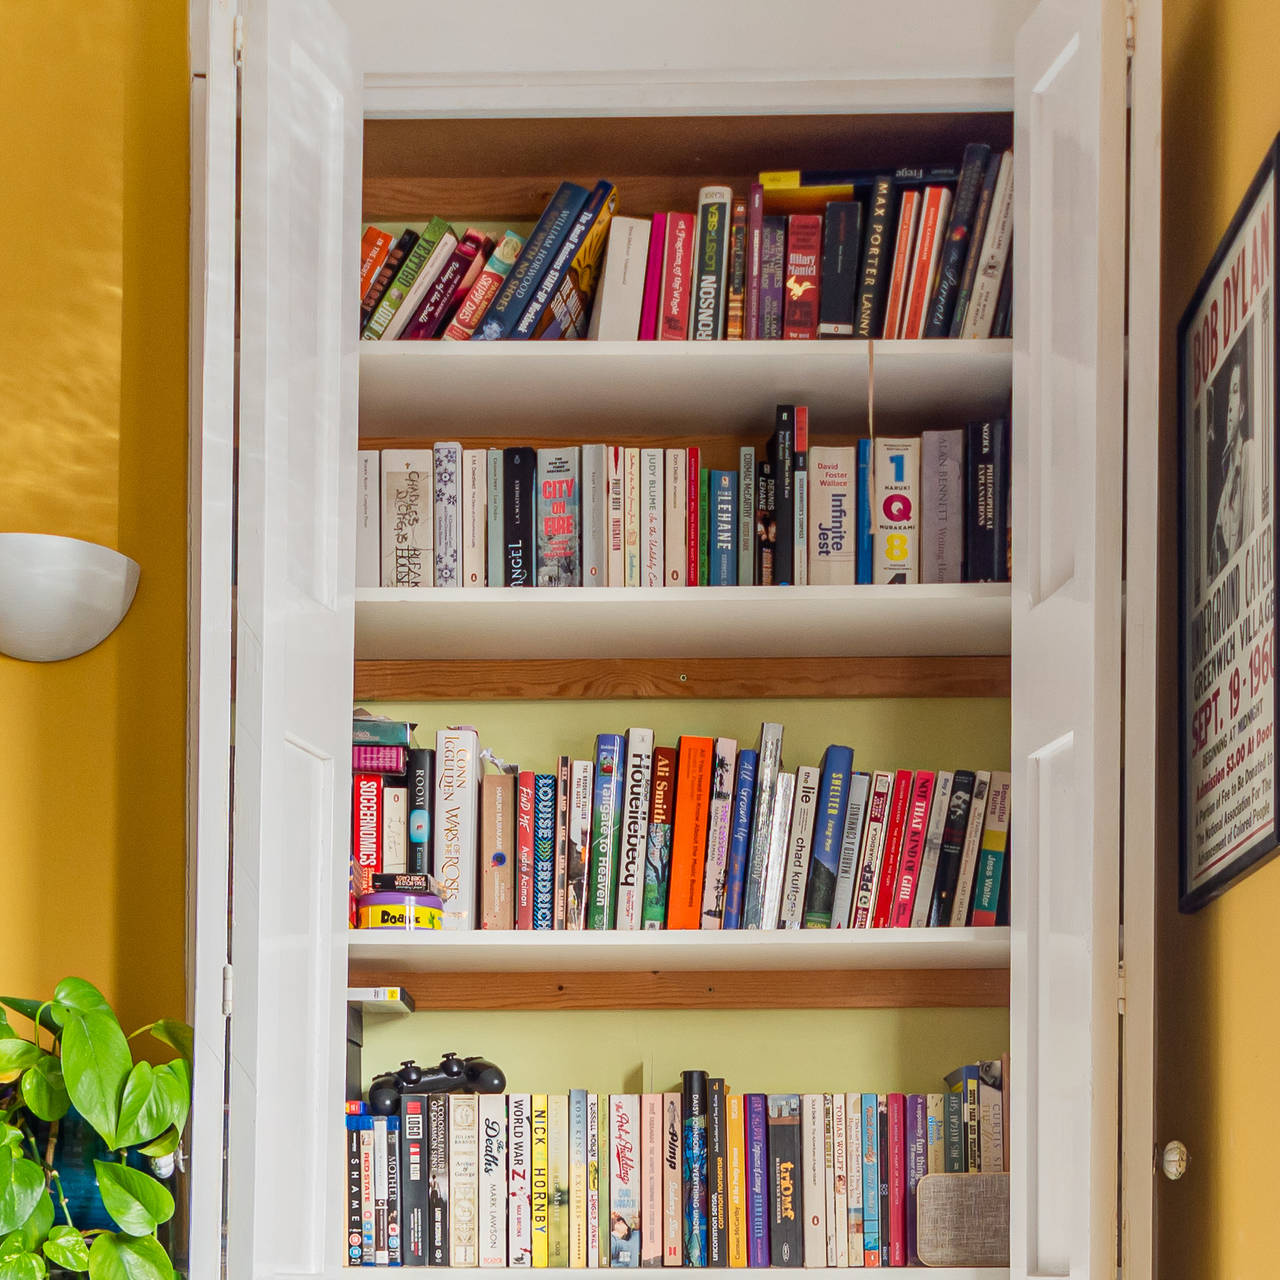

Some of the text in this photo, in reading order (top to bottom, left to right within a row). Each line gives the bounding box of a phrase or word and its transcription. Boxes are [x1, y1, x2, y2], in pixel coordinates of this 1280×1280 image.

[398, 238, 437, 287] VERTIGO
[516, 210, 571, 298] WILLIAM HORWOOD
[518, 212, 592, 333] The Small Business START-UP Workbook
[788, 264, 816, 276] Mantel
[789, 254, 816, 265] Hilary
[859, 182, 888, 337] MAX PORTER LANNY
[459, 274, 492, 322] SKIPPY DIES
[698, 275, 717, 340] RONSON
[1194, 203, 1269, 400] BOB DYLAN
[542, 478, 575, 500] CITY
[647, 453, 656, 477] JUDY
[743, 453, 752, 518] CORMAC McCARTHY
[543, 516, 574, 536] FIRE
[552, 501, 566, 515] ON
[612, 478, 620, 551] PHILIP ROTH INDIGNATION
[832, 493, 846, 551] Infinite
[818, 522, 831, 556] Jest
[1191, 524, 1273, 672] UNDERGROUND CAVER
[1194, 588, 1274, 701] GREENWICH VILLAGE
[1192, 687, 1223, 758] SEPT.
[1229, 667, 1240, 719] 19
[1202, 697, 1263, 769] BEGINNING AT MIDNIGHT
[439, 736, 460, 802] IGGULDEN
[457, 749, 468, 789] CONN
[1196, 767, 1225, 803] Admission
[1226, 743, 1245, 776] $3.00
[1256, 723, 1273, 748] Door
[1245, 752, 1266, 784] Donated
[416, 770, 425, 805] ROOM
[519, 787, 532, 832] FIND ME
[654, 755, 669, 823] Ali Smith
[800, 786, 815, 804] lie
[827, 773, 842, 815] SHELTER
[919, 778, 930, 799] NOT
[990, 790, 1000, 815] Ruins
[998, 784, 1009, 823] Beautiful
[1223, 778, 1271, 826] Association For The
[360, 781, 377, 865] SOCCERNOMICS
[621, 753, 650, 887] Houellebecq
[912, 801, 926, 830] THAT
[1233, 799, 1270, 840] Colored People
[537, 779, 552, 929] LOUISE ERDRICH
[596, 782, 612, 906] Tailgate to Heaven
[793, 838, 806, 868] chad
[908, 831, 919, 858] KIND
[900, 875, 914, 901] GIRL
[982, 855, 996, 907] Jess Walter
[408, 1117, 420, 1137] LOGO
[484, 1118, 500, 1176] Deaths
[512, 1100, 526, 1181] WORLD WAR Z
[388, 1156, 396, 1201] MOTHER
[534, 1110, 546, 1233] NICK HORNBY
